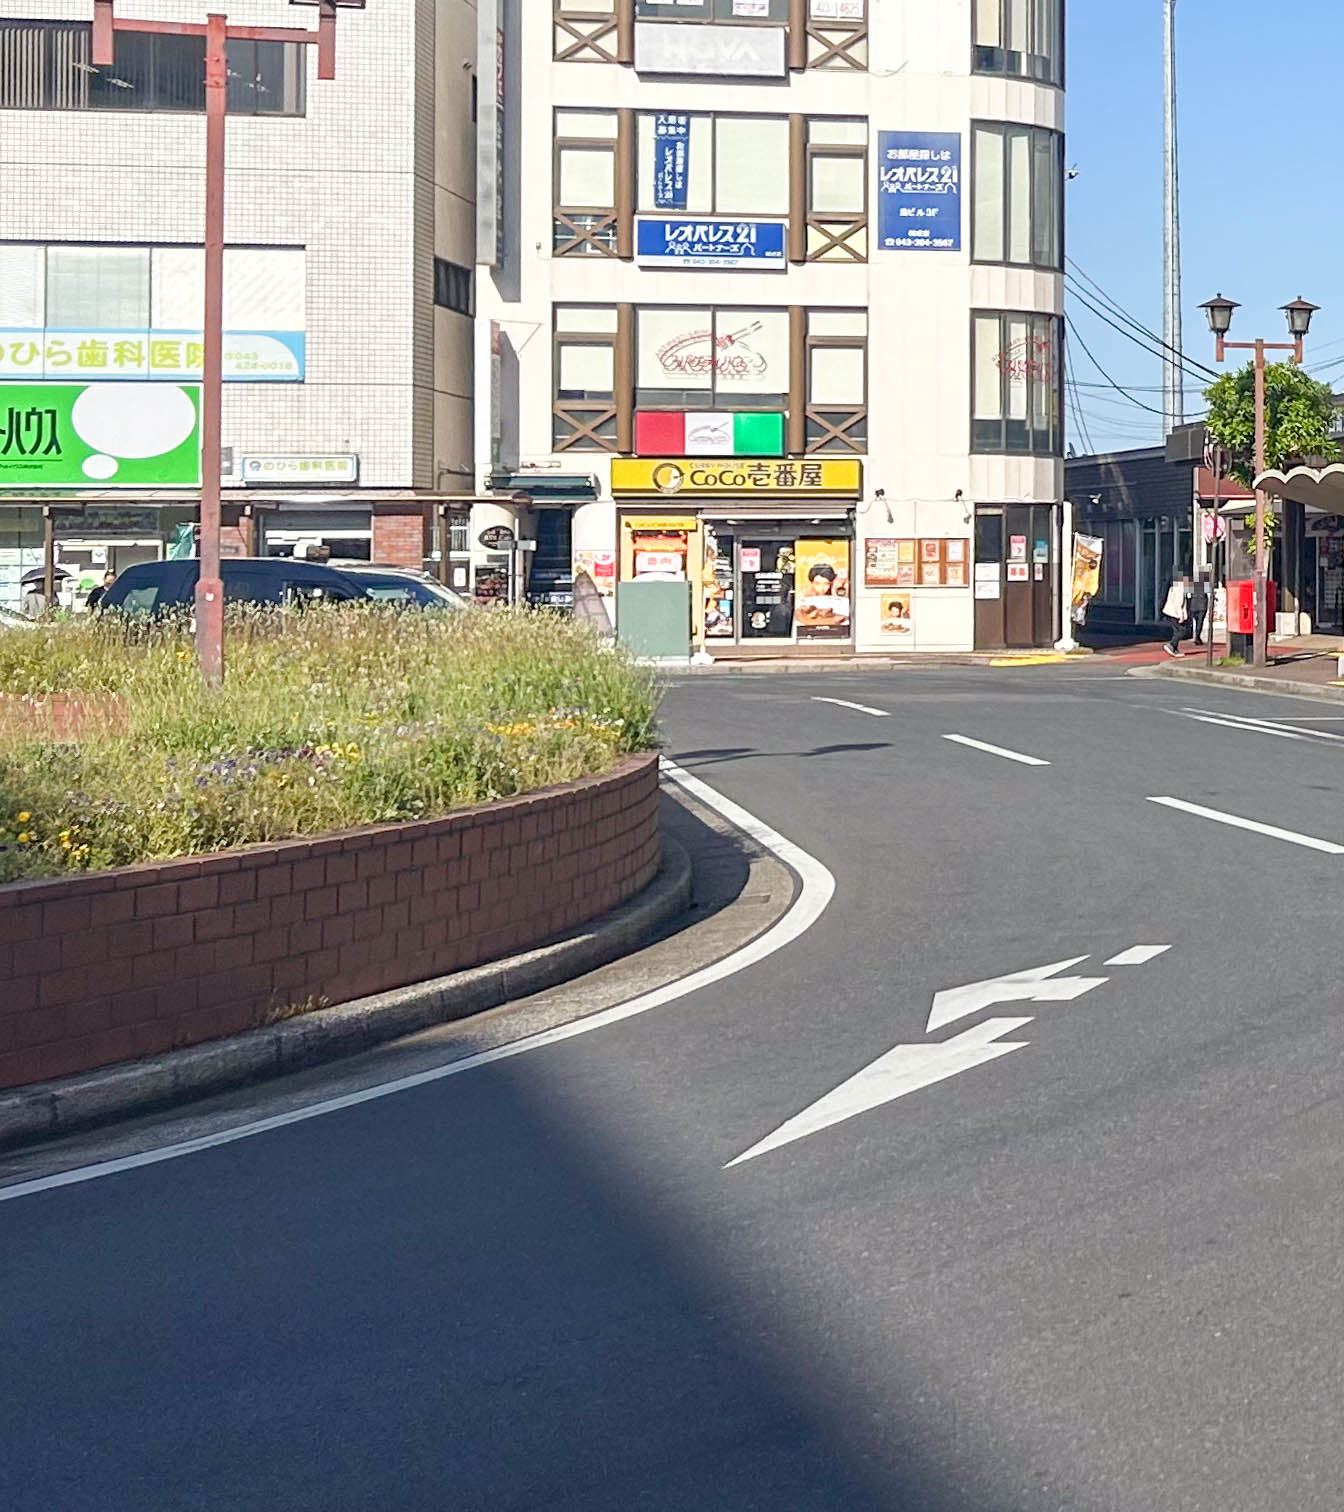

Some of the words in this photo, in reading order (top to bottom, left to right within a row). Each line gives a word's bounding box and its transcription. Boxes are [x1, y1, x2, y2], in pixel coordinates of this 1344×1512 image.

[880, 165, 958, 183] レオパレス21
[665, 223, 757, 243] レオパレス21
[690, 463, 833, 487] CoCo壱番屋
